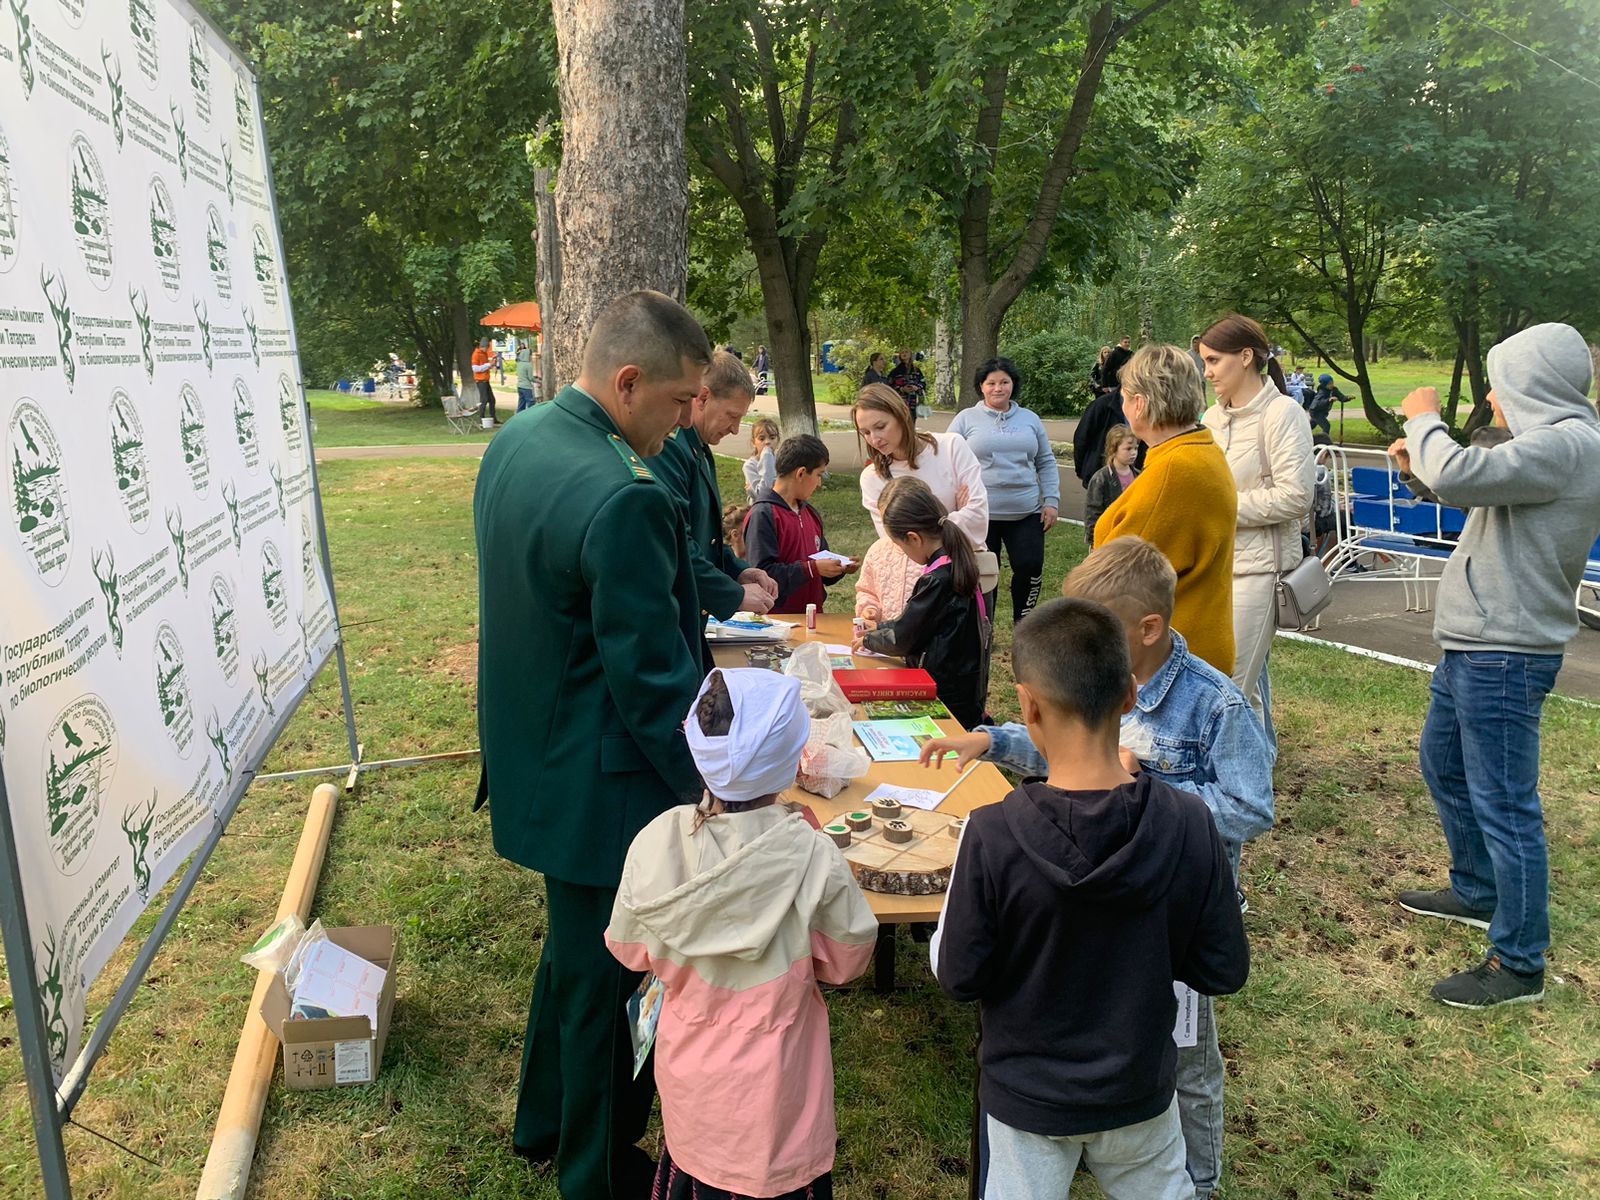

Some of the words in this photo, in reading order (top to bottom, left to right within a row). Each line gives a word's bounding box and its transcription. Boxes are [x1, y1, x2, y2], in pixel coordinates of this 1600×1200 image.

[4, 609, 75, 663] Государственный
[74, 597, 95, 620] комитет
[6, 647, 66, 687] Республики
[65, 624, 89, 654] Татарстан
[10, 694, 19, 711] по
[19, 653, 87, 701] биологическим
[86, 632, 107, 664] ресурсам
[94, 855, 120, 891] комитет
[78, 889, 109, 936] Татарстан
[99, 884, 129, 932] ресурсам
